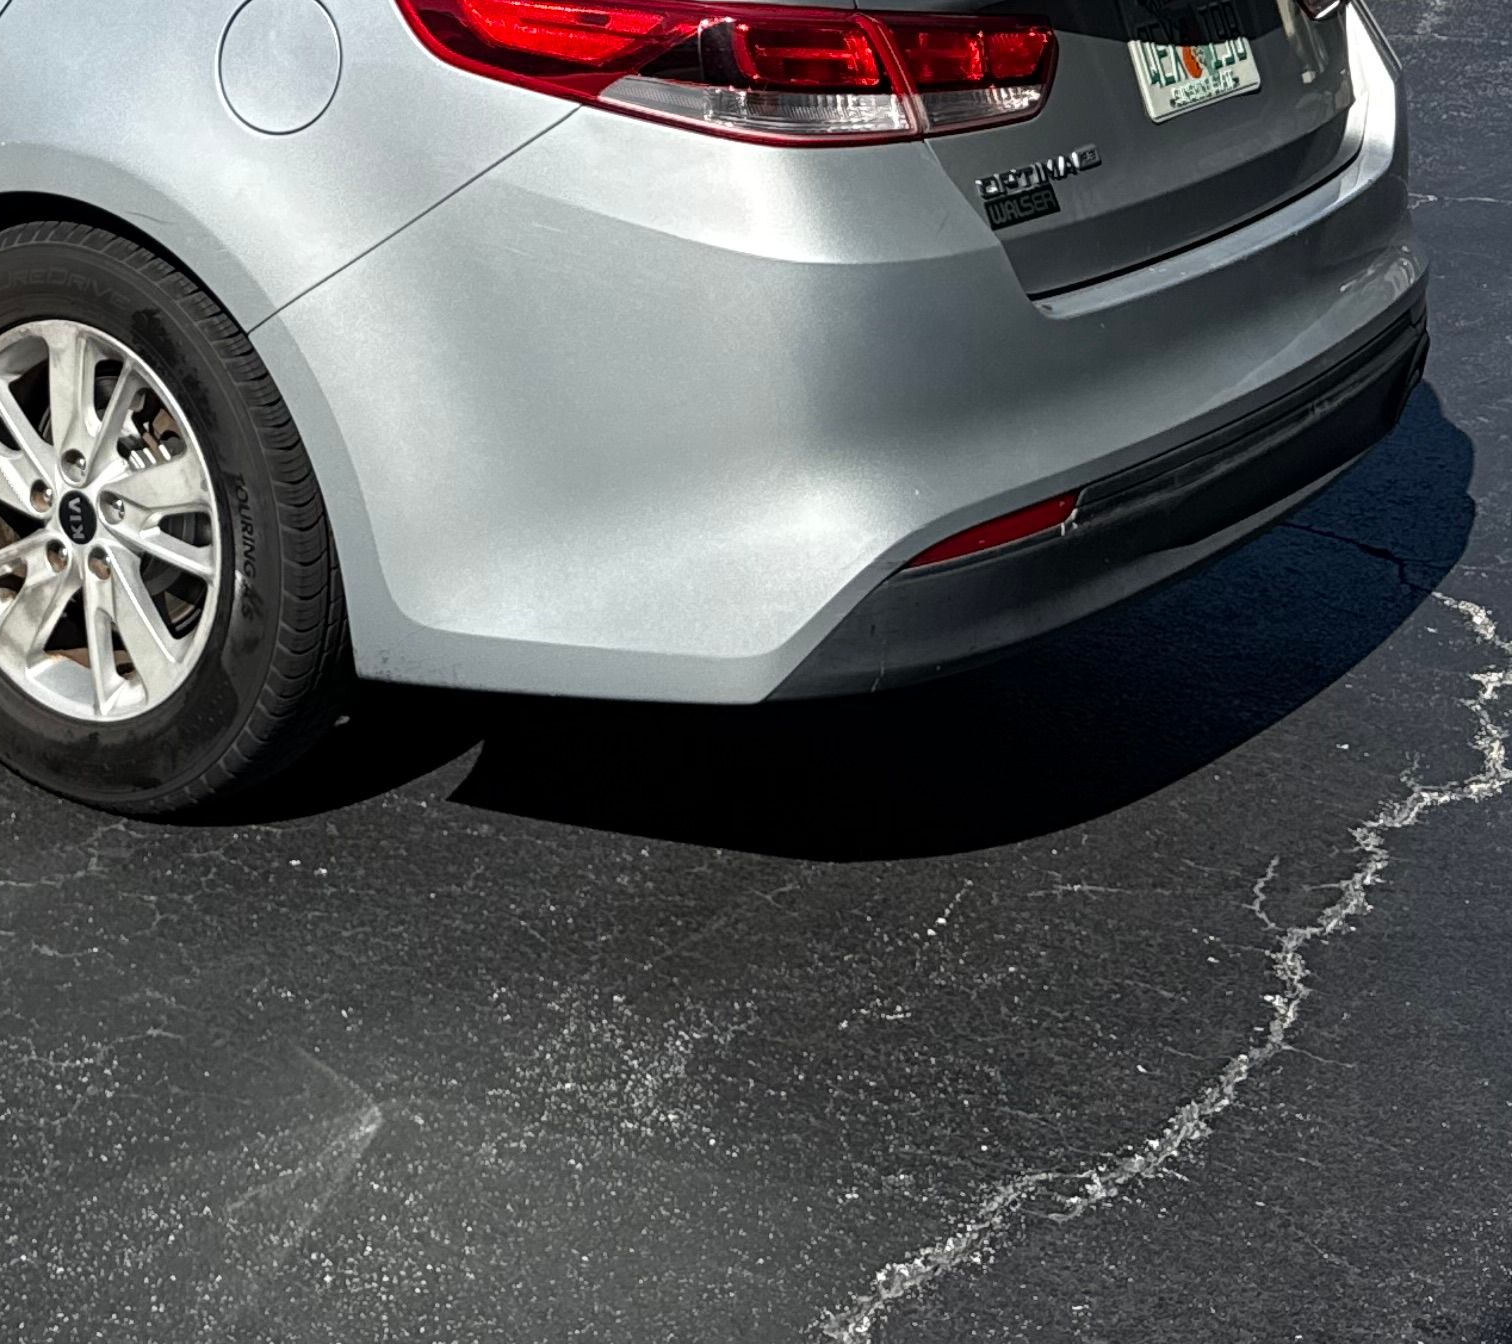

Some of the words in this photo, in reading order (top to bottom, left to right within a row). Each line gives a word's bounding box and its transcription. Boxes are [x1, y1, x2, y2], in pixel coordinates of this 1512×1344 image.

[974, 151, 1080, 200] OPTIMA
[988, 191, 1057, 225] WALSER
[68, 496, 85, 539] KIA
[235, 472, 257, 579] TOURING
